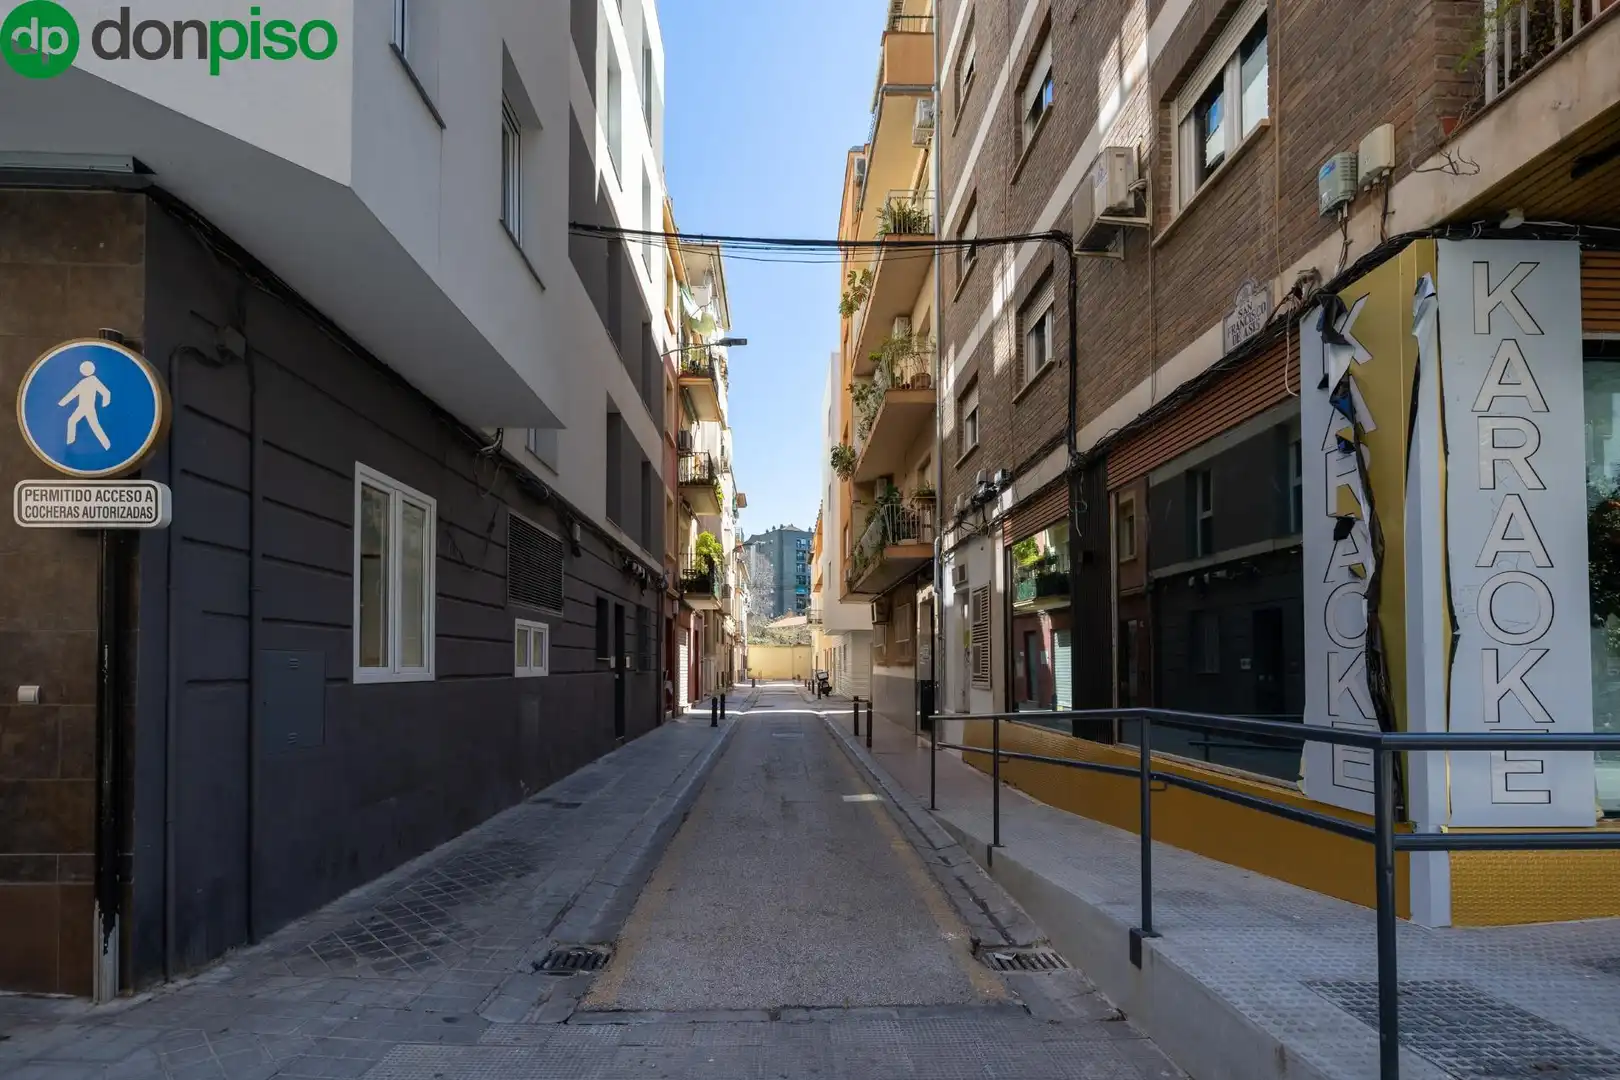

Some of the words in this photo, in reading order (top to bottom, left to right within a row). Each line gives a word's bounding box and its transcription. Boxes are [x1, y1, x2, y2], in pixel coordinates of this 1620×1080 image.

[1238, 301, 1253, 319] SAN
[1227, 302, 1266, 338] FRANCISCO
[25, 489, 92, 502] PERMITIDO
[95, 489, 143, 502] ACCESO
[145, 489, 153, 502] A
[25, 505, 80, 519] COCHERAS
[82, 505, 153, 519] AUTORIZADAS
[1471, 260, 1555, 804] KARAOKE
